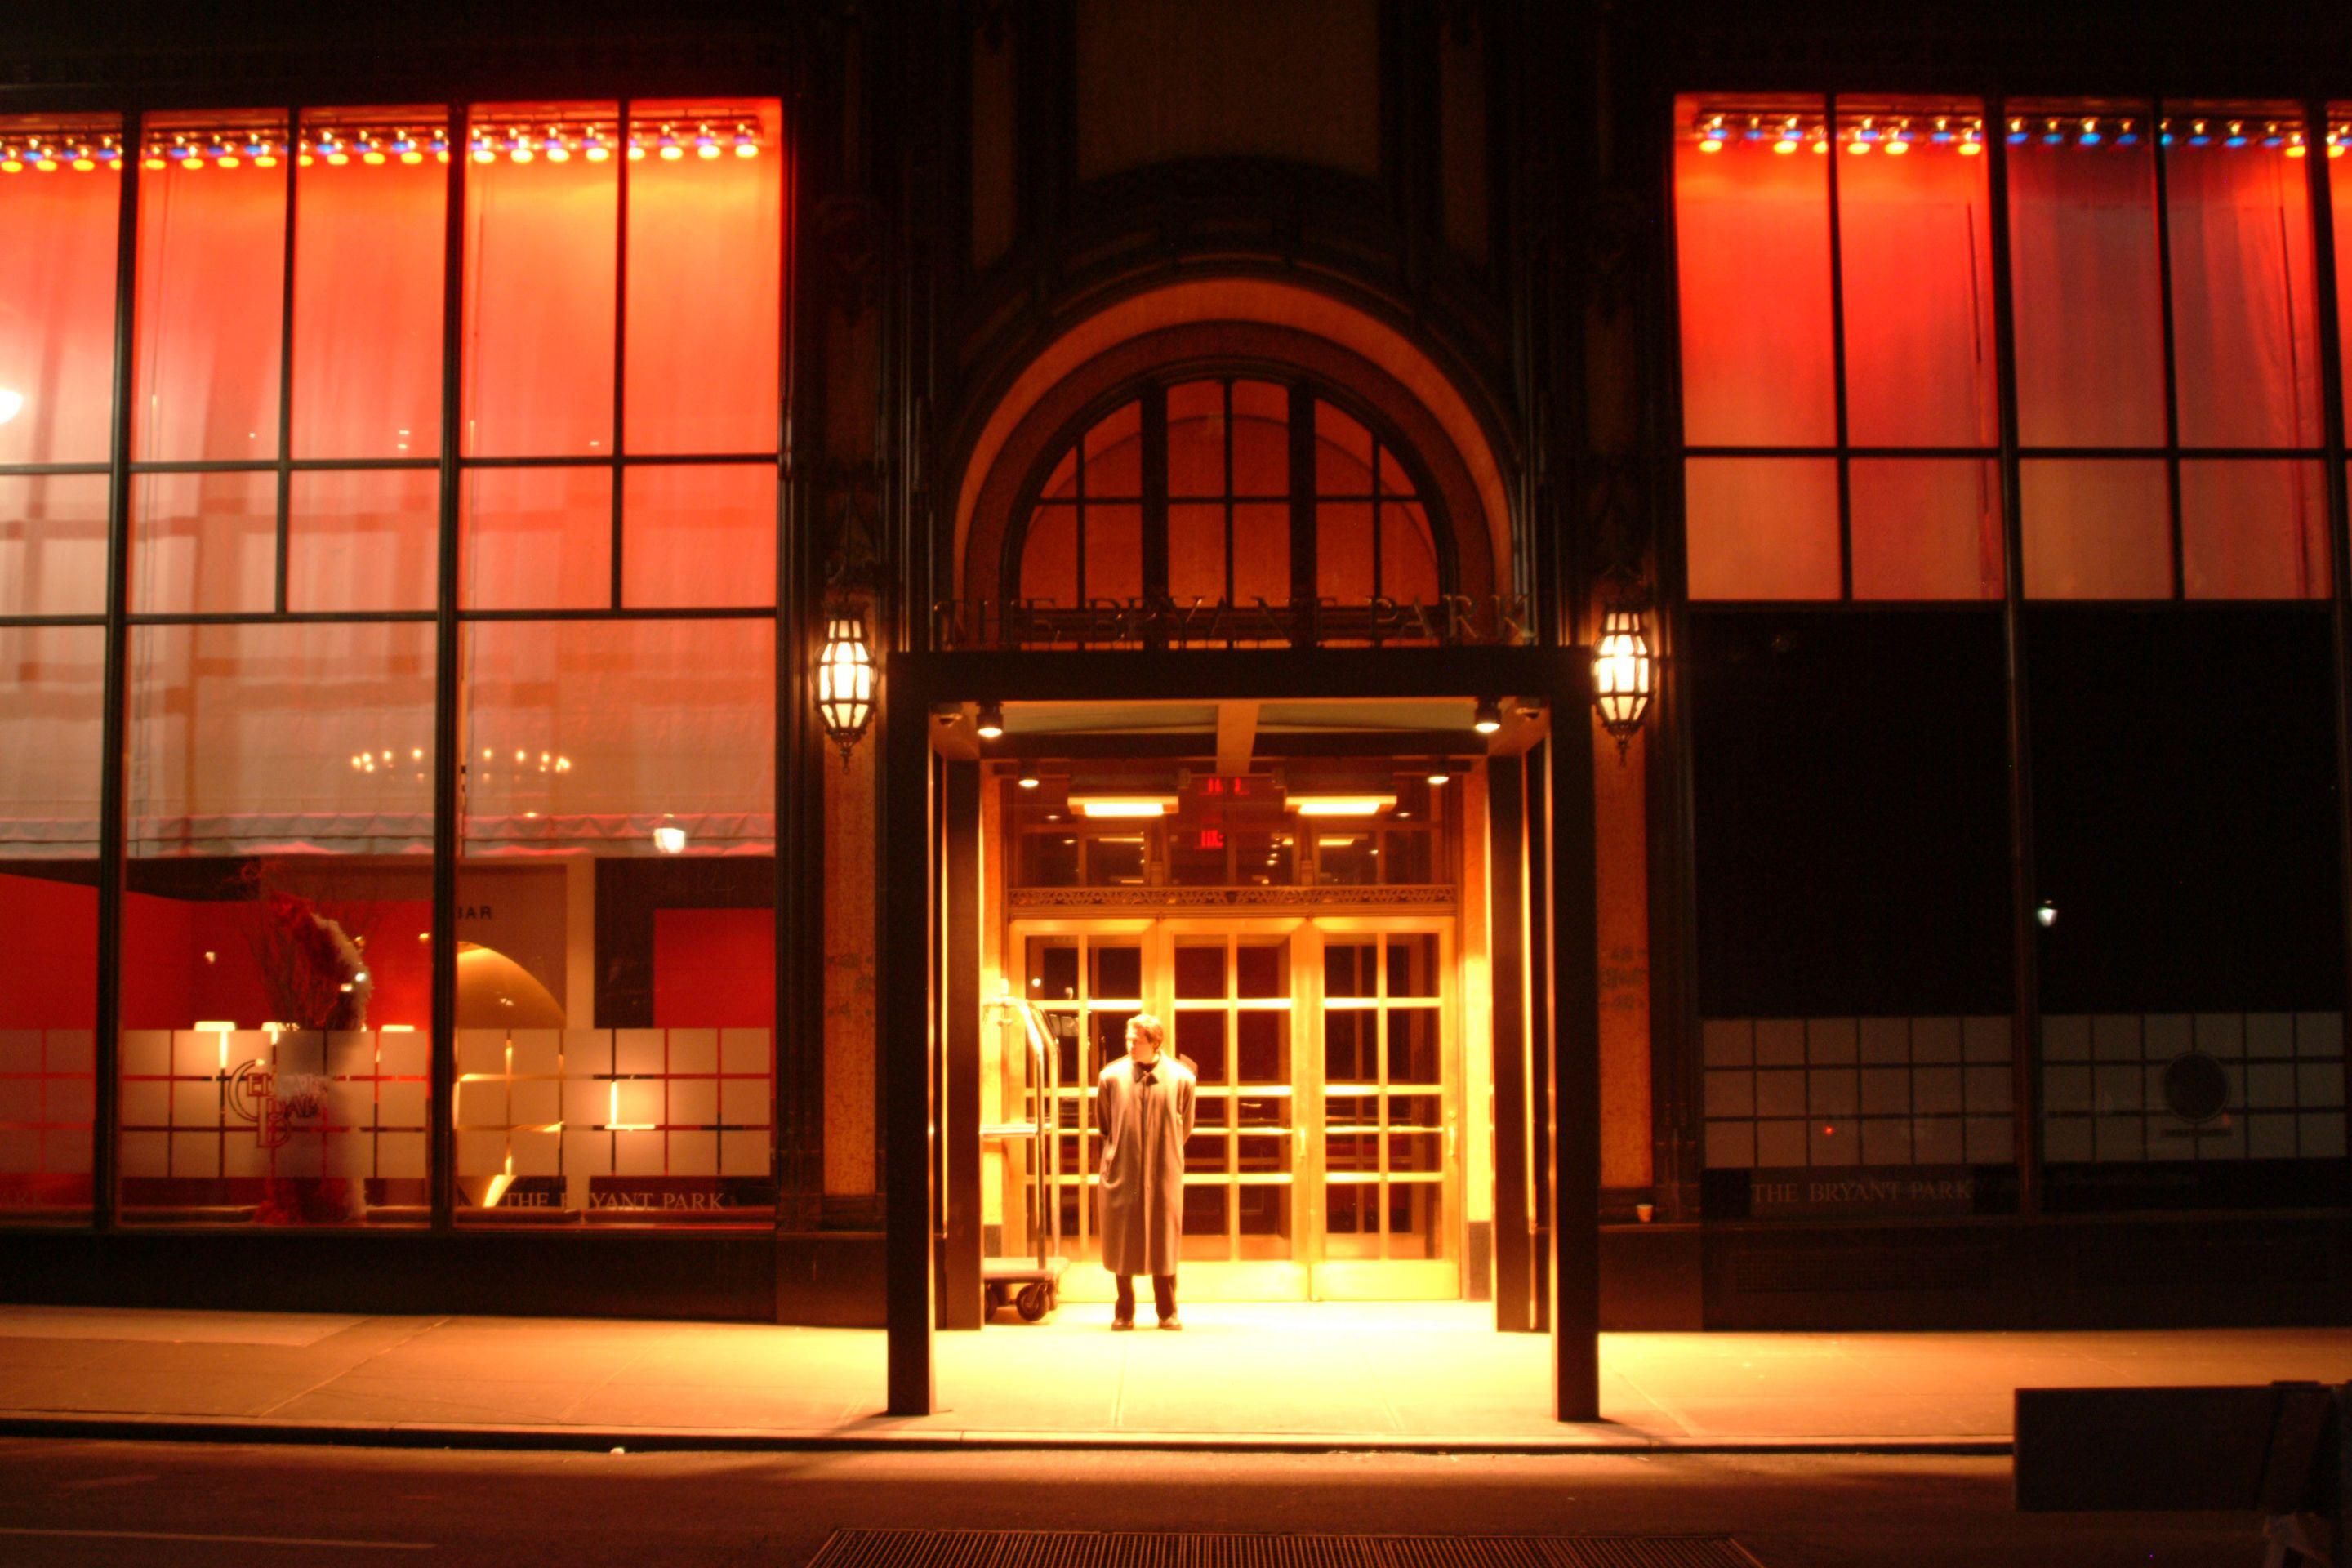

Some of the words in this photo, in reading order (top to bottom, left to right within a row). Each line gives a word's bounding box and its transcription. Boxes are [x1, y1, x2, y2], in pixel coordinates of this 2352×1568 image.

[1365, 594, 1534, 642] PARK
[504, 1192, 549, 1209] THE
[561, 1192, 655, 1210] YANT
[662, 1192, 725, 1210] PARK
[1750, 1183, 1797, 1203] THE
[1808, 1181, 1902, 1202] BRYANT
[1909, 1179, 1974, 1200] PARK
